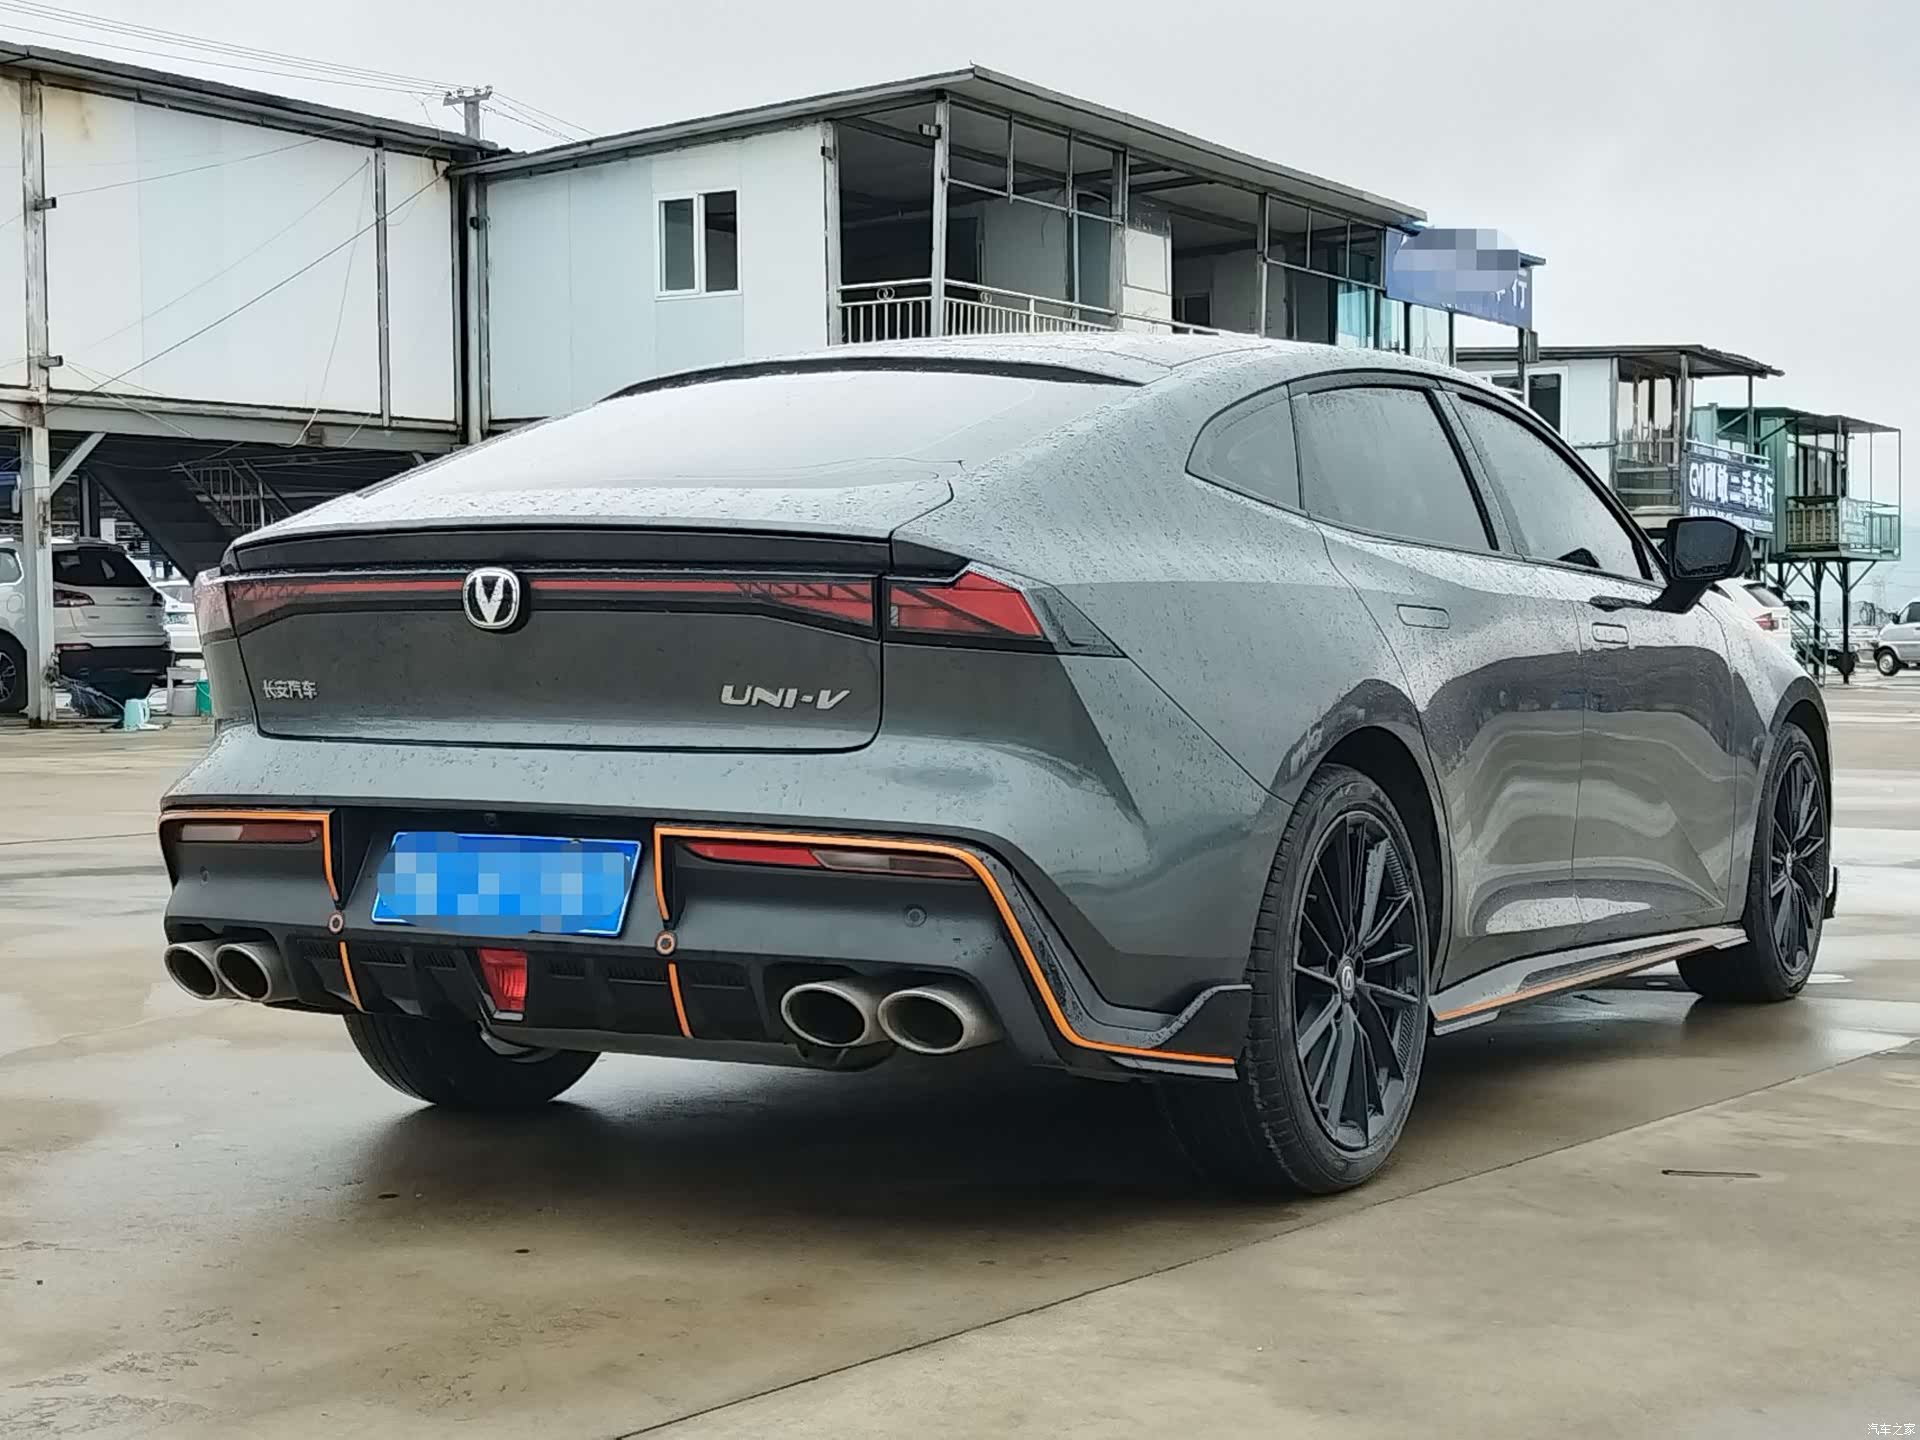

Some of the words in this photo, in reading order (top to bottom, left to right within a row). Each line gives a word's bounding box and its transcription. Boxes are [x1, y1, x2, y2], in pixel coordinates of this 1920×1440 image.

[263, 680, 318, 699] 长安汽车
[721, 685, 850, 710] UNI-V
